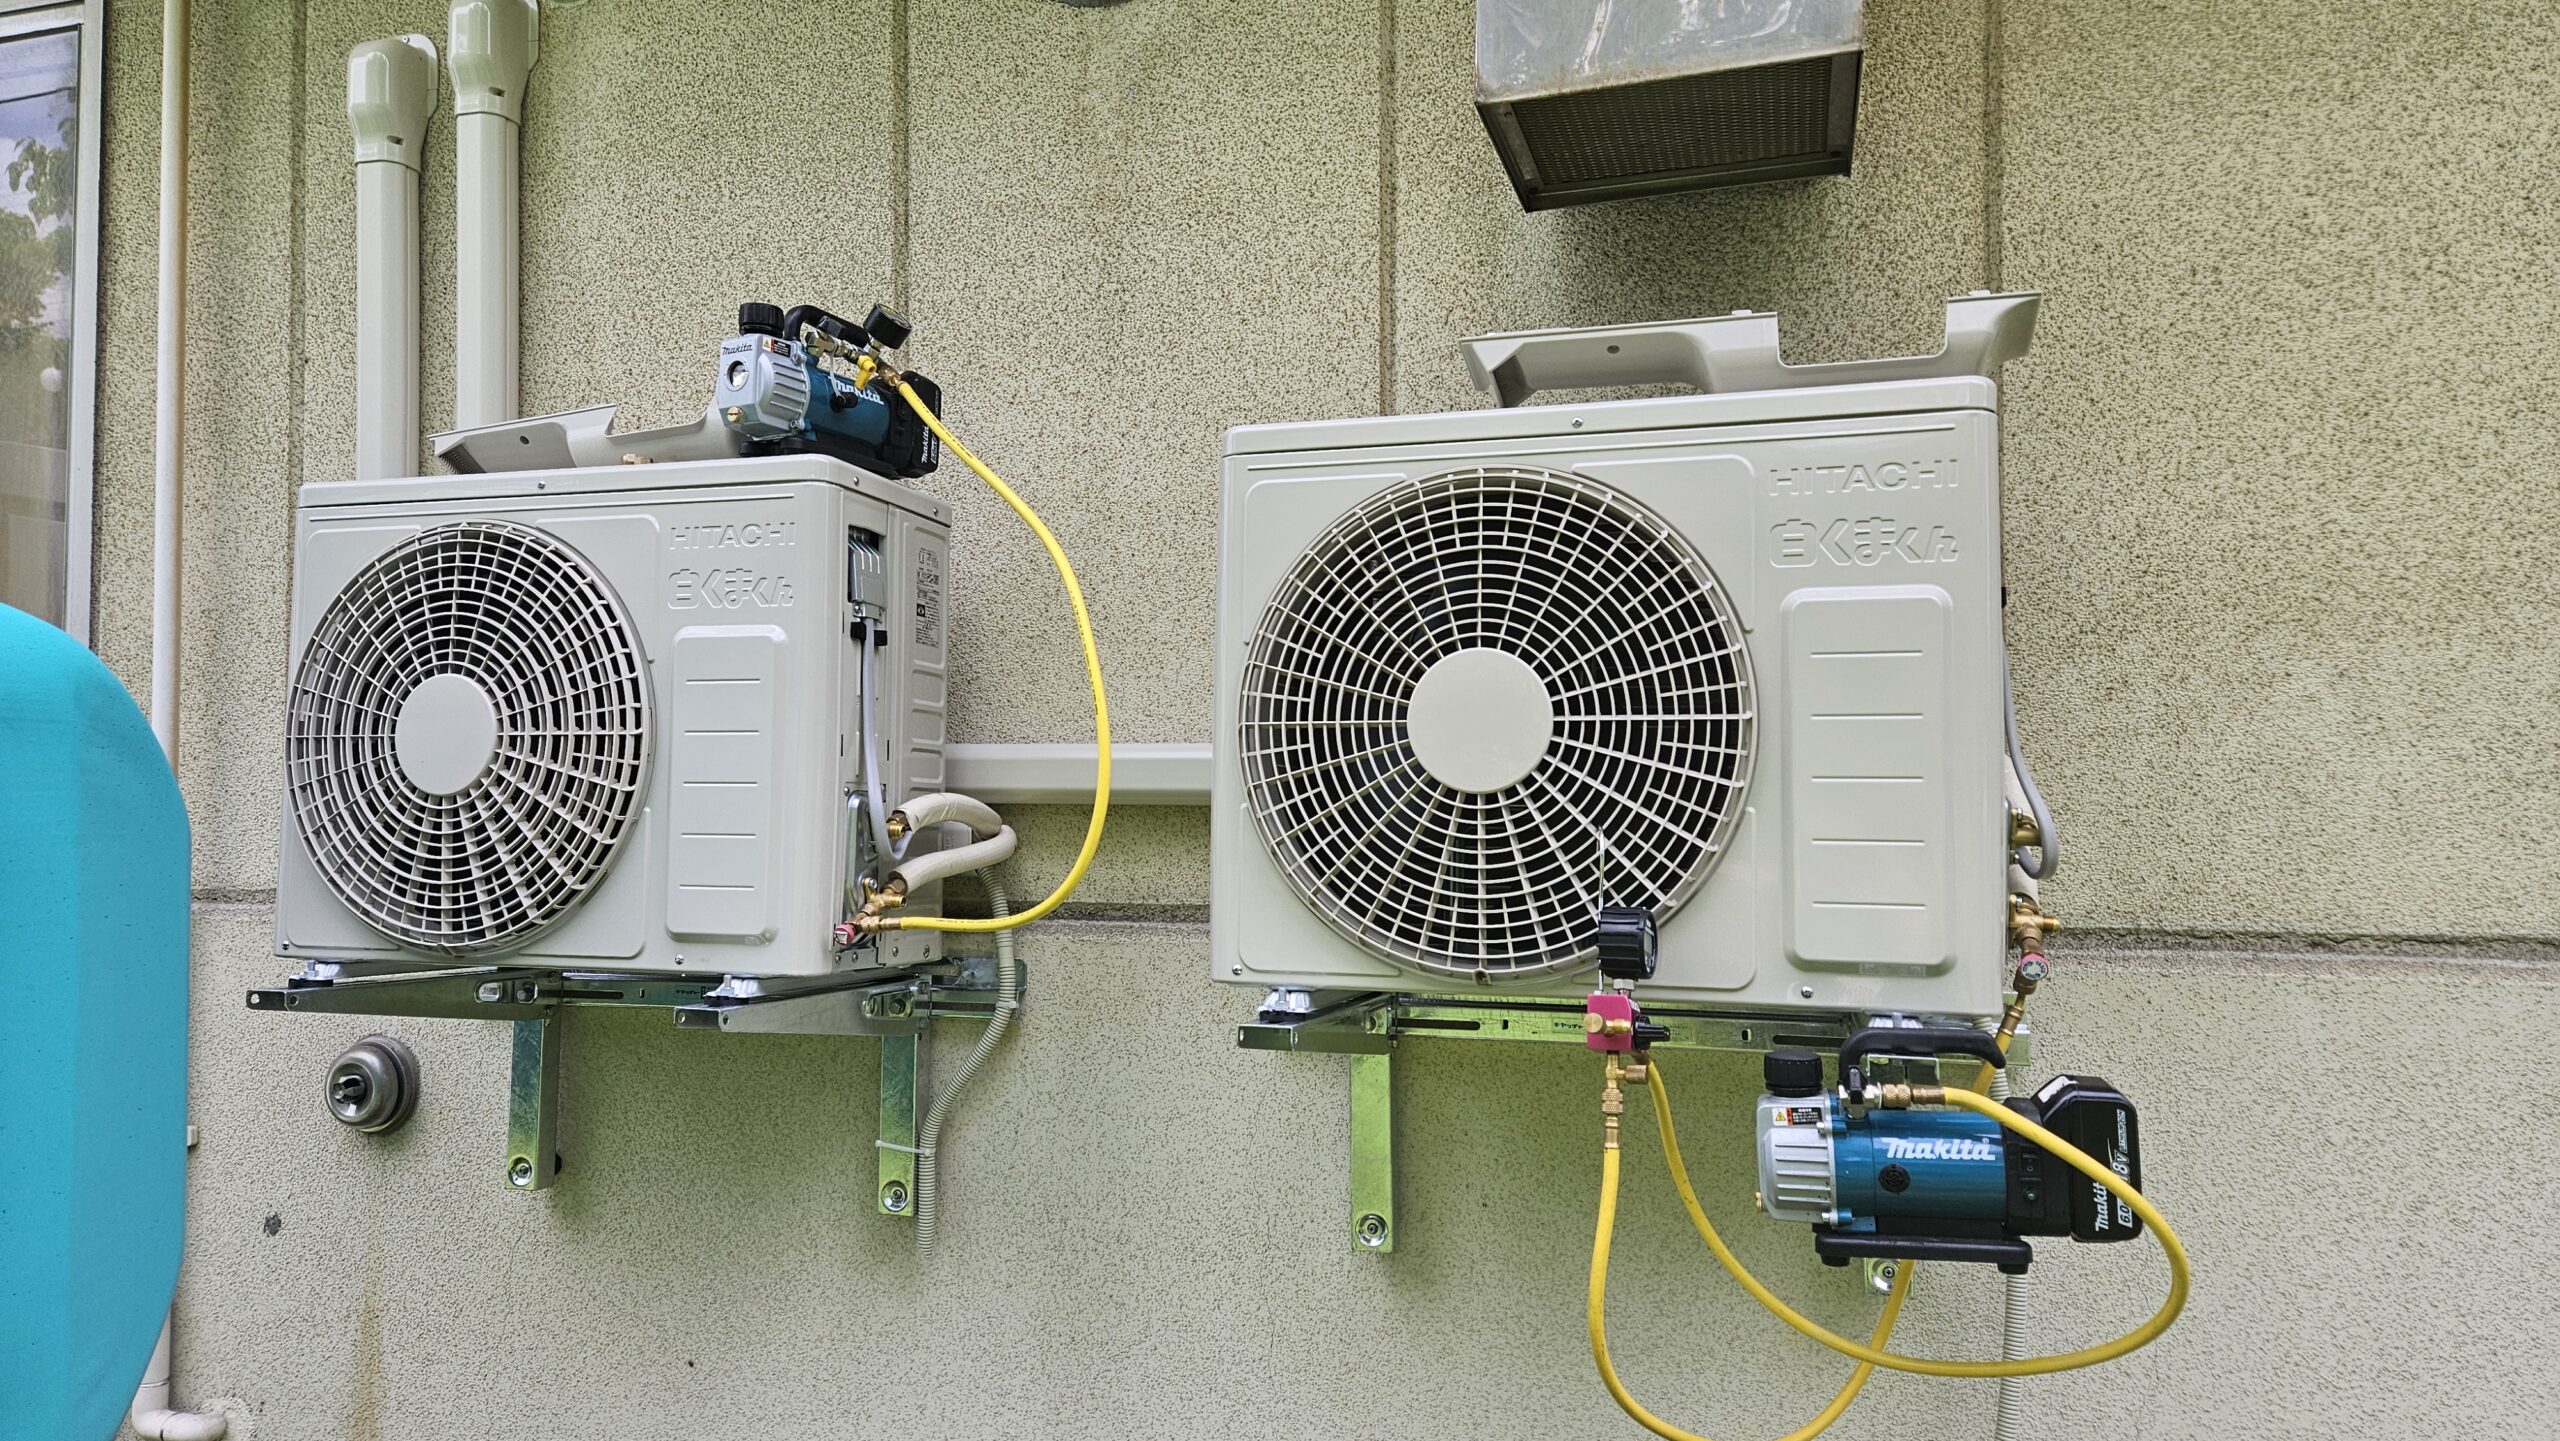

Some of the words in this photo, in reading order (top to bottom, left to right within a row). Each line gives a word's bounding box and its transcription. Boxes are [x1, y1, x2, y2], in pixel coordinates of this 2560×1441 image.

[1769, 458, 1959, 497] HITACHI
[669, 522, 797, 550] HITACHI
[1769, 516, 1959, 569] 白くまくん
[667, 568, 795, 610] 白くまくん
[2119, 1202, 2131, 1224] 6.0
